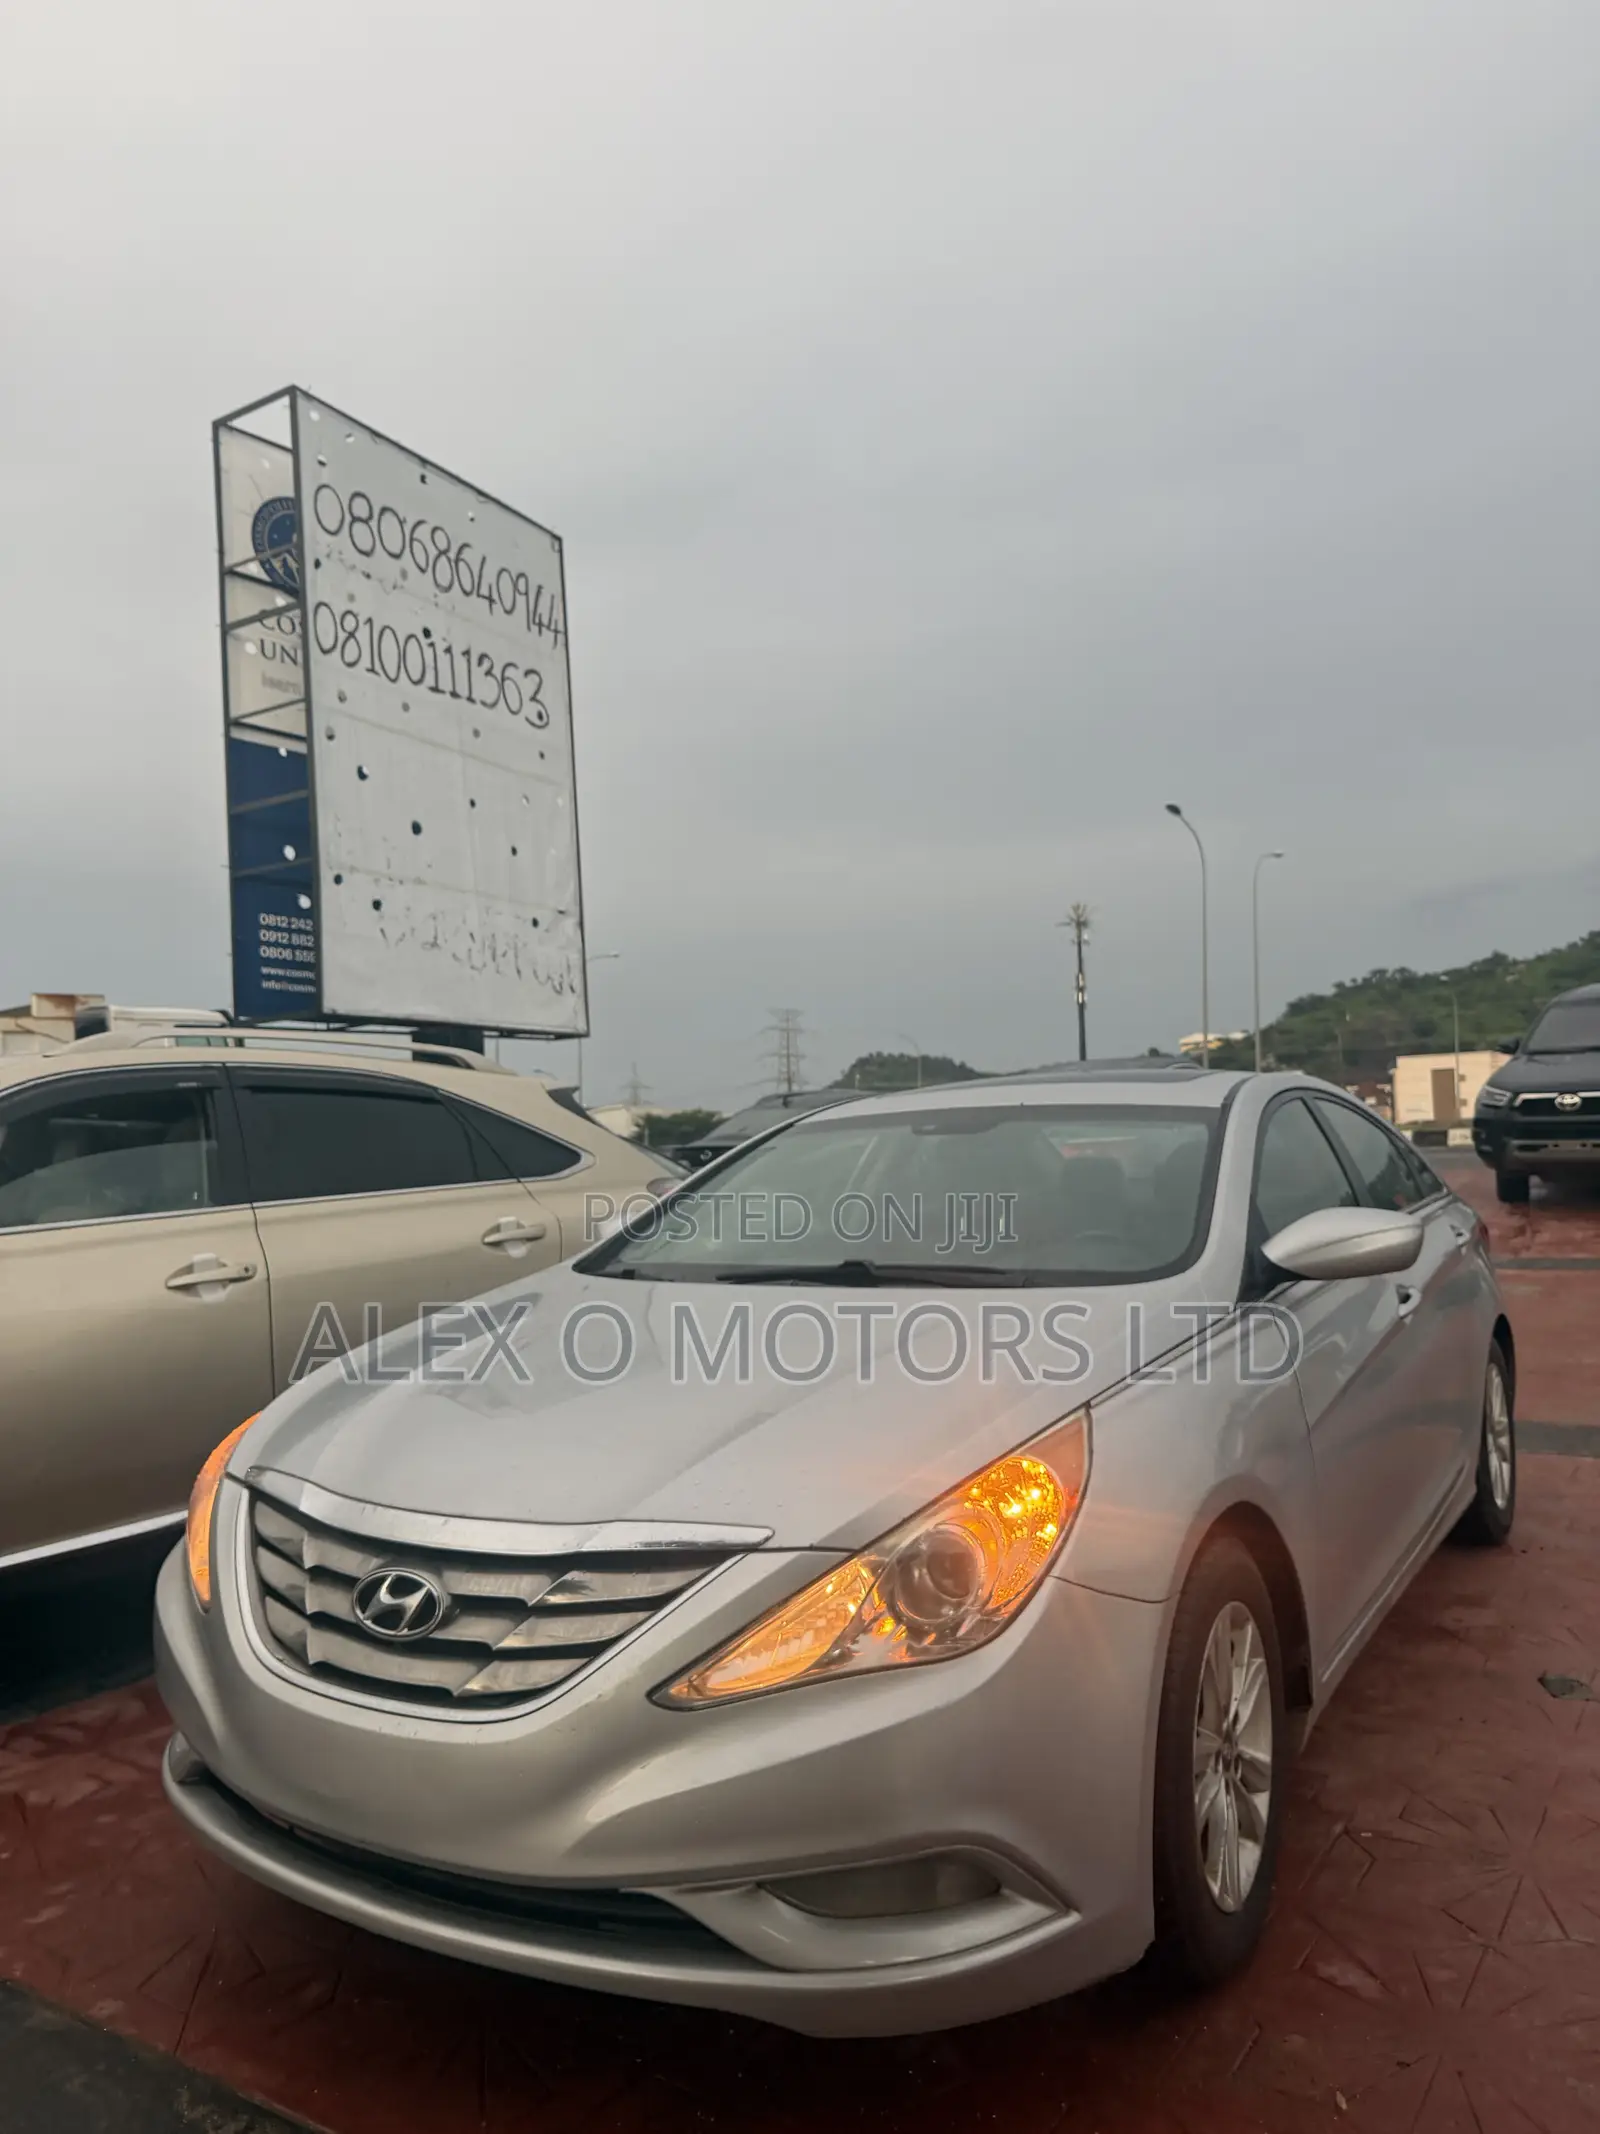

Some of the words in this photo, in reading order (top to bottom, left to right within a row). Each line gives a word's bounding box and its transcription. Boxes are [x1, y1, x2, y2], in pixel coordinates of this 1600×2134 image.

[314, 484, 566, 648] 08068640944
[259, 609, 303, 638] CO
[314, 602, 549, 729] 08100111363
[259, 913, 289, 929] 0812
[259, 929, 289, 945] 0912
[259, 945, 293, 960] 0806
